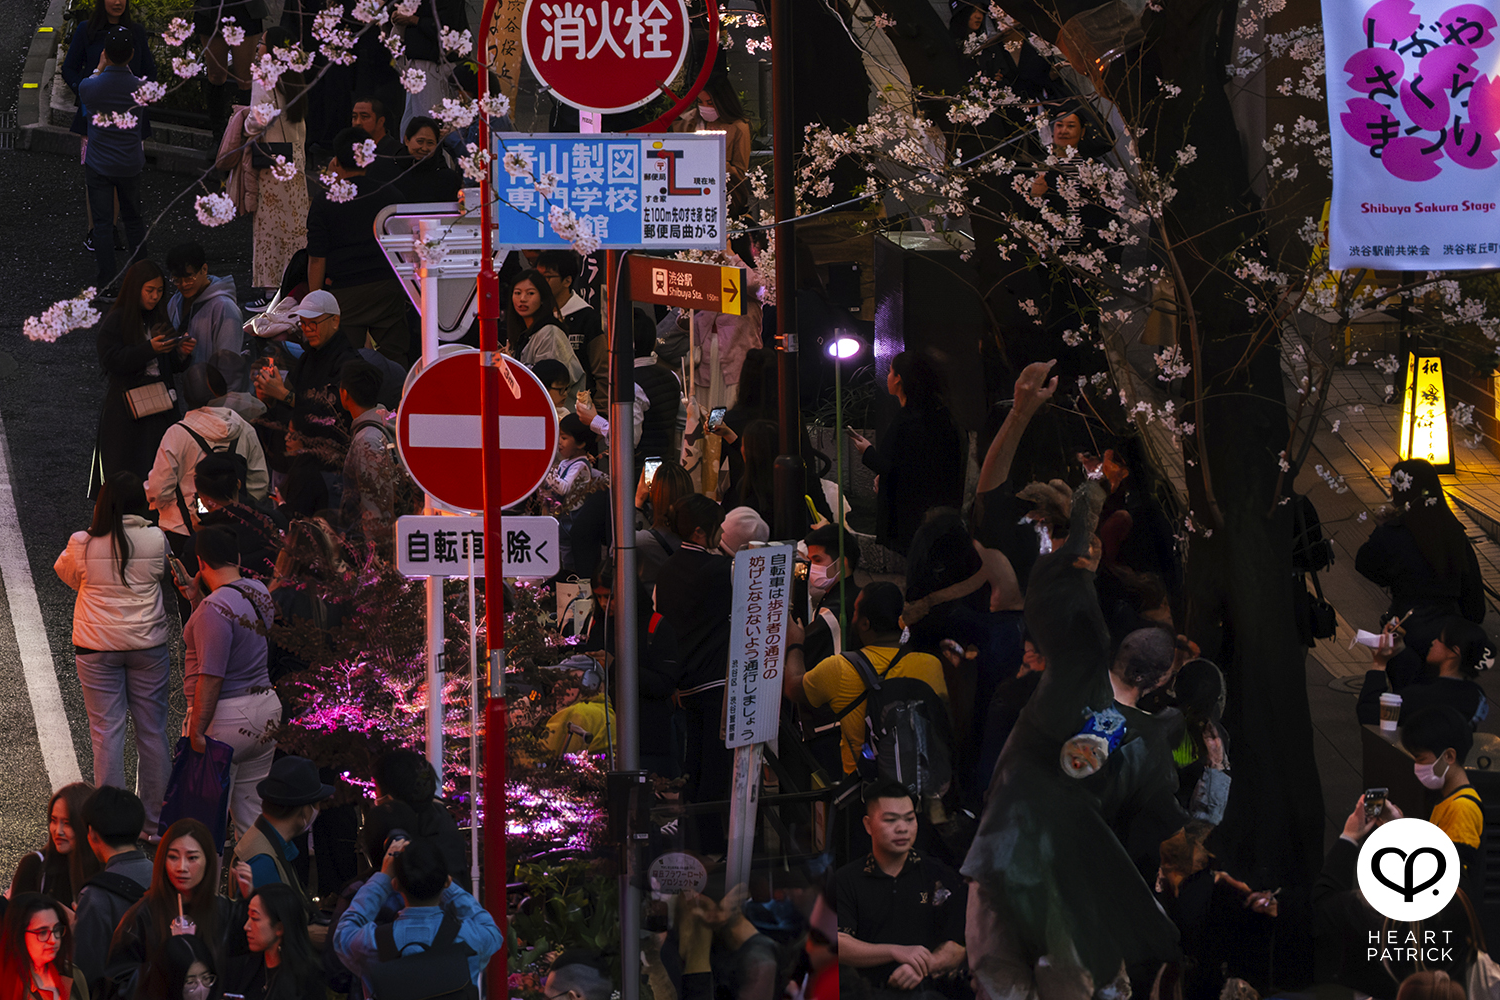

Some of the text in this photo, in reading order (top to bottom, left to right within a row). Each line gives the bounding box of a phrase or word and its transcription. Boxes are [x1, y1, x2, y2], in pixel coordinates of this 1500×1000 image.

[1365, 63, 1475, 110] さくら
[1366, 114, 1482, 158] まつり
[643, 173, 666, 181] 郵便局
[693, 177, 716, 185] 現在地
[505, 186, 638, 213] 専門学校
[645, 195, 667, 203] すき家
[1361, 200, 1496, 215] Shibuya Sakura Stage
[538, 214, 609, 239] 1館
[643, 223, 718, 239] 郵便局曲がる
[1349, 242, 1500, 257] 渋谷駅前共栄会 渋谷桜丘町
[668, 270, 693, 287] 渋谷駅
[669, 286, 692, 300] Shibuya
[407, 529, 549, 564] 自転車除く
[762, 553, 787, 680] 自転車は歩行者の通行の
[740, 555, 766, 741] 妨げとならないよう通行しましょう
